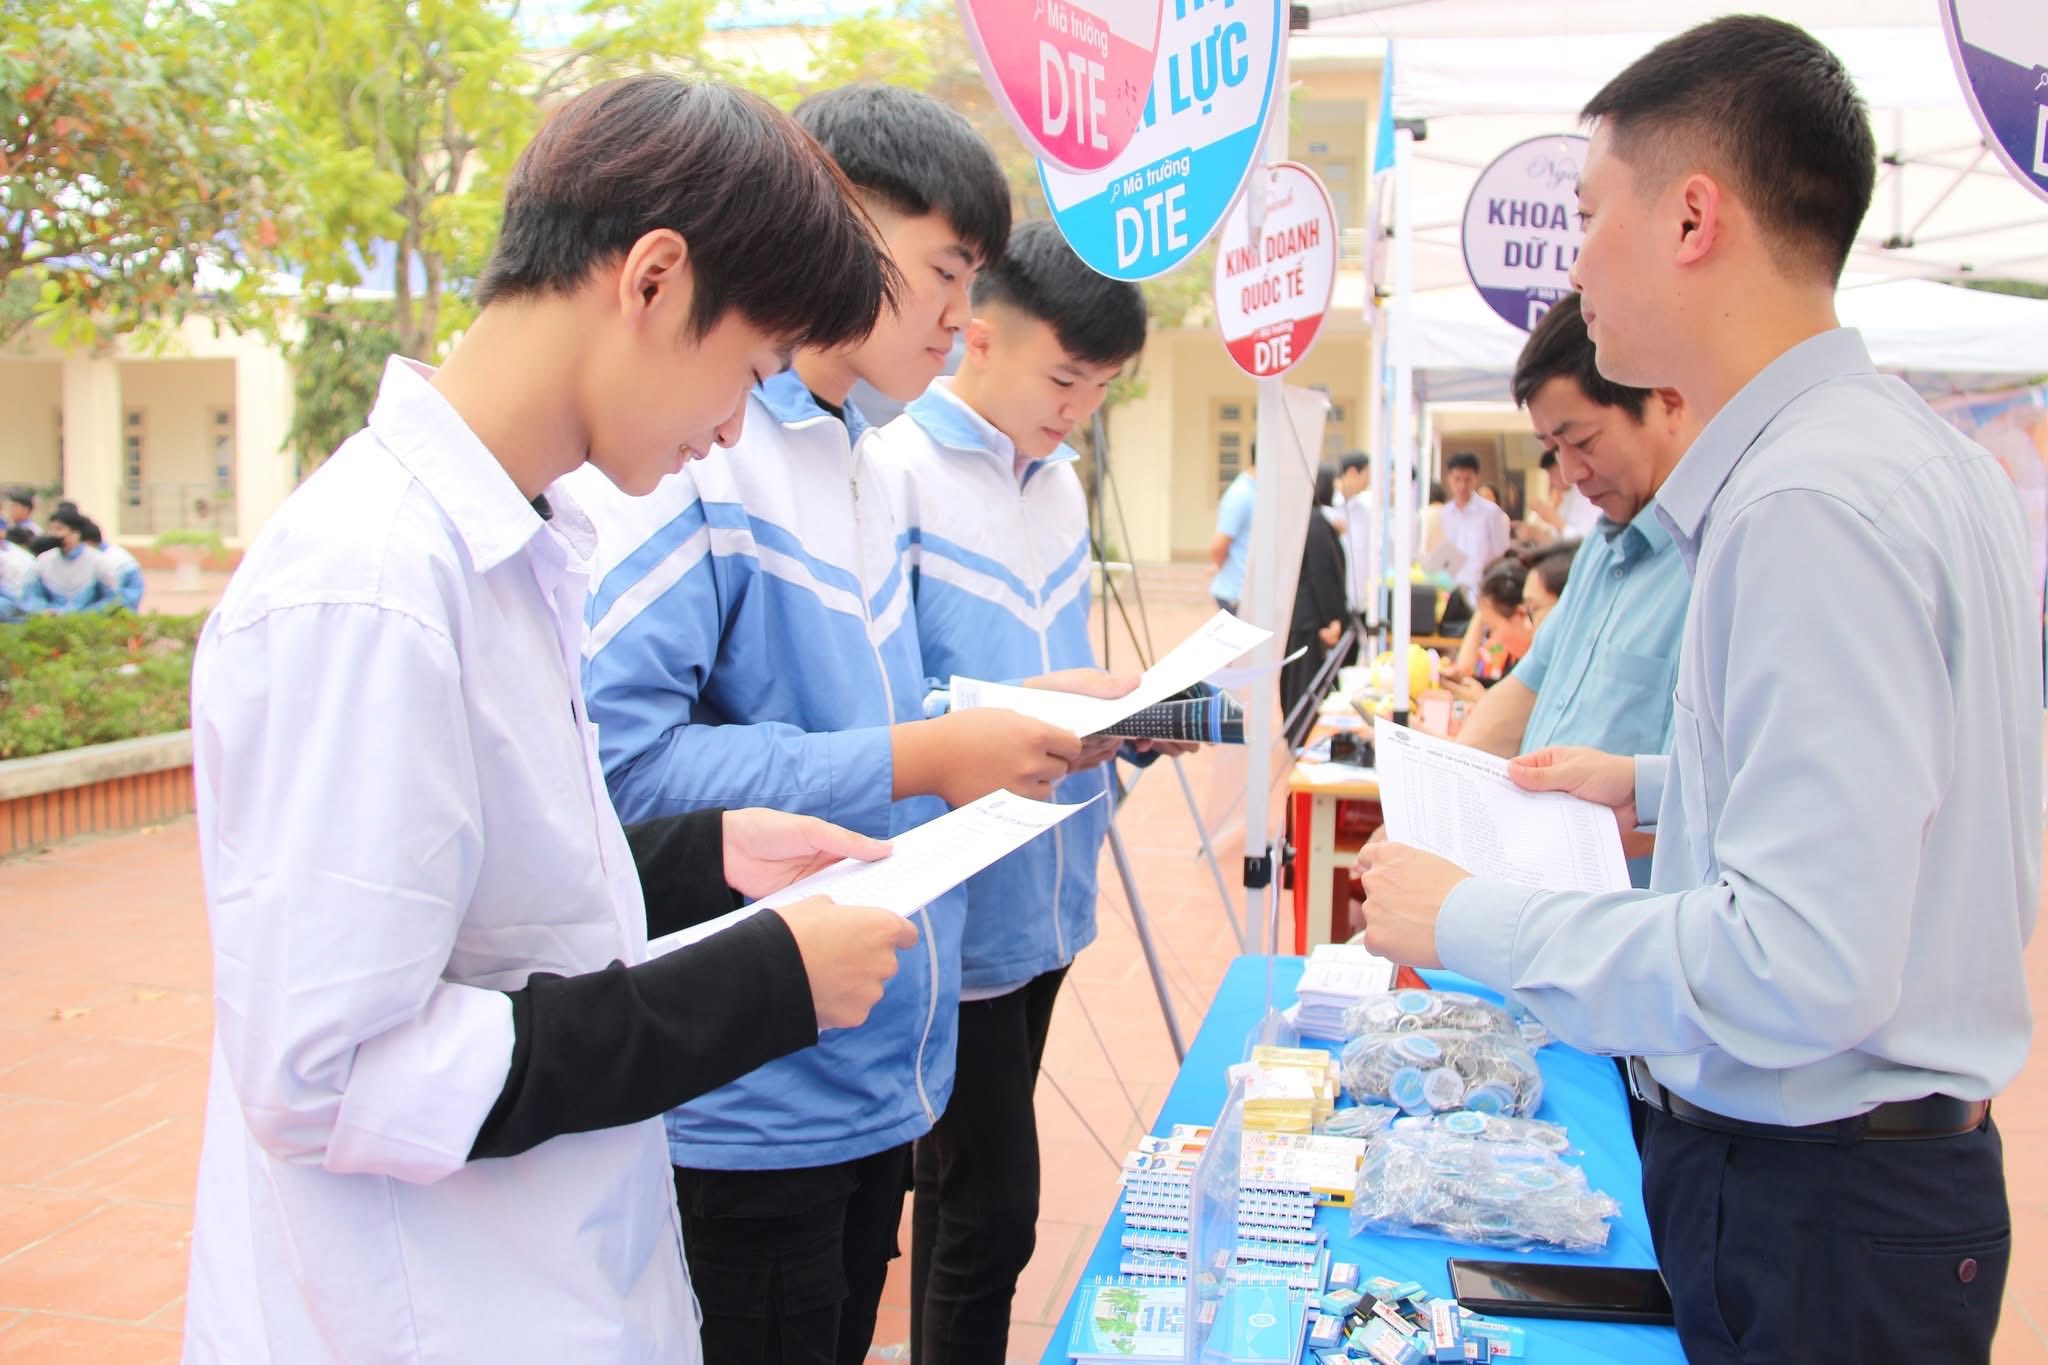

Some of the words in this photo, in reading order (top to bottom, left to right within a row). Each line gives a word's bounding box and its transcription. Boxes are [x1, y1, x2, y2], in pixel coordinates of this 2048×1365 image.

[1047, 0, 1068, 33] Mã
[1168, 21, 1249, 115] LỰC
[1039, 39, 1109, 152] DTE
[1122, 172, 1143, 197] Mã
[1146, 154, 1190, 187] trường
[1115, 182, 1188, 270] DTE
[1487, 198, 1568, 231] KHOA
[1225, 242, 1262, 278] KINH
[1265, 217, 1320, 264] DOANH
[1503, 235, 1548, 270] DỮ
[1241, 266, 1281, 315] QUỐC
[1285, 256, 1305, 299] TẾ
[1253, 333, 1293, 374] DTE
